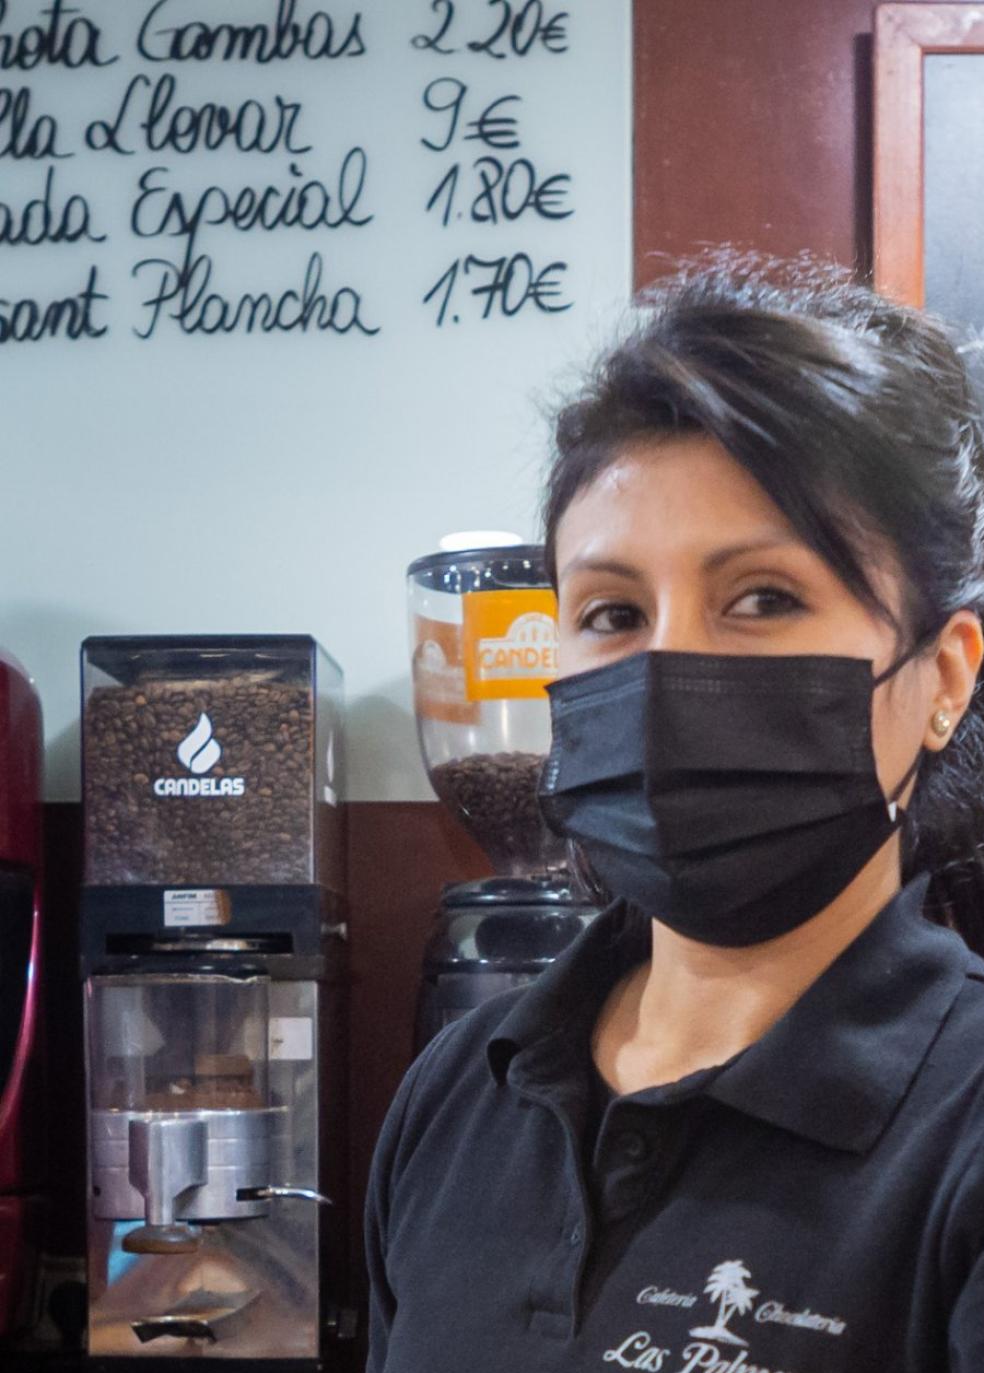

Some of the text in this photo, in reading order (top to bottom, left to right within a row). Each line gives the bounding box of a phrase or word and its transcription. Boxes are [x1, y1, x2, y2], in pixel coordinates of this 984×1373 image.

[421, 77, 522, 152] 9€
[131, 147, 374, 290] Especial
[425, 155, 575, 227] 1.80€
[131, 252, 381, 340] Plancha
[423, 251, 575, 327] 1.70€
[153, 777, 246, 796] CANDELAS
[603, 1331, 671, 1373] Las
